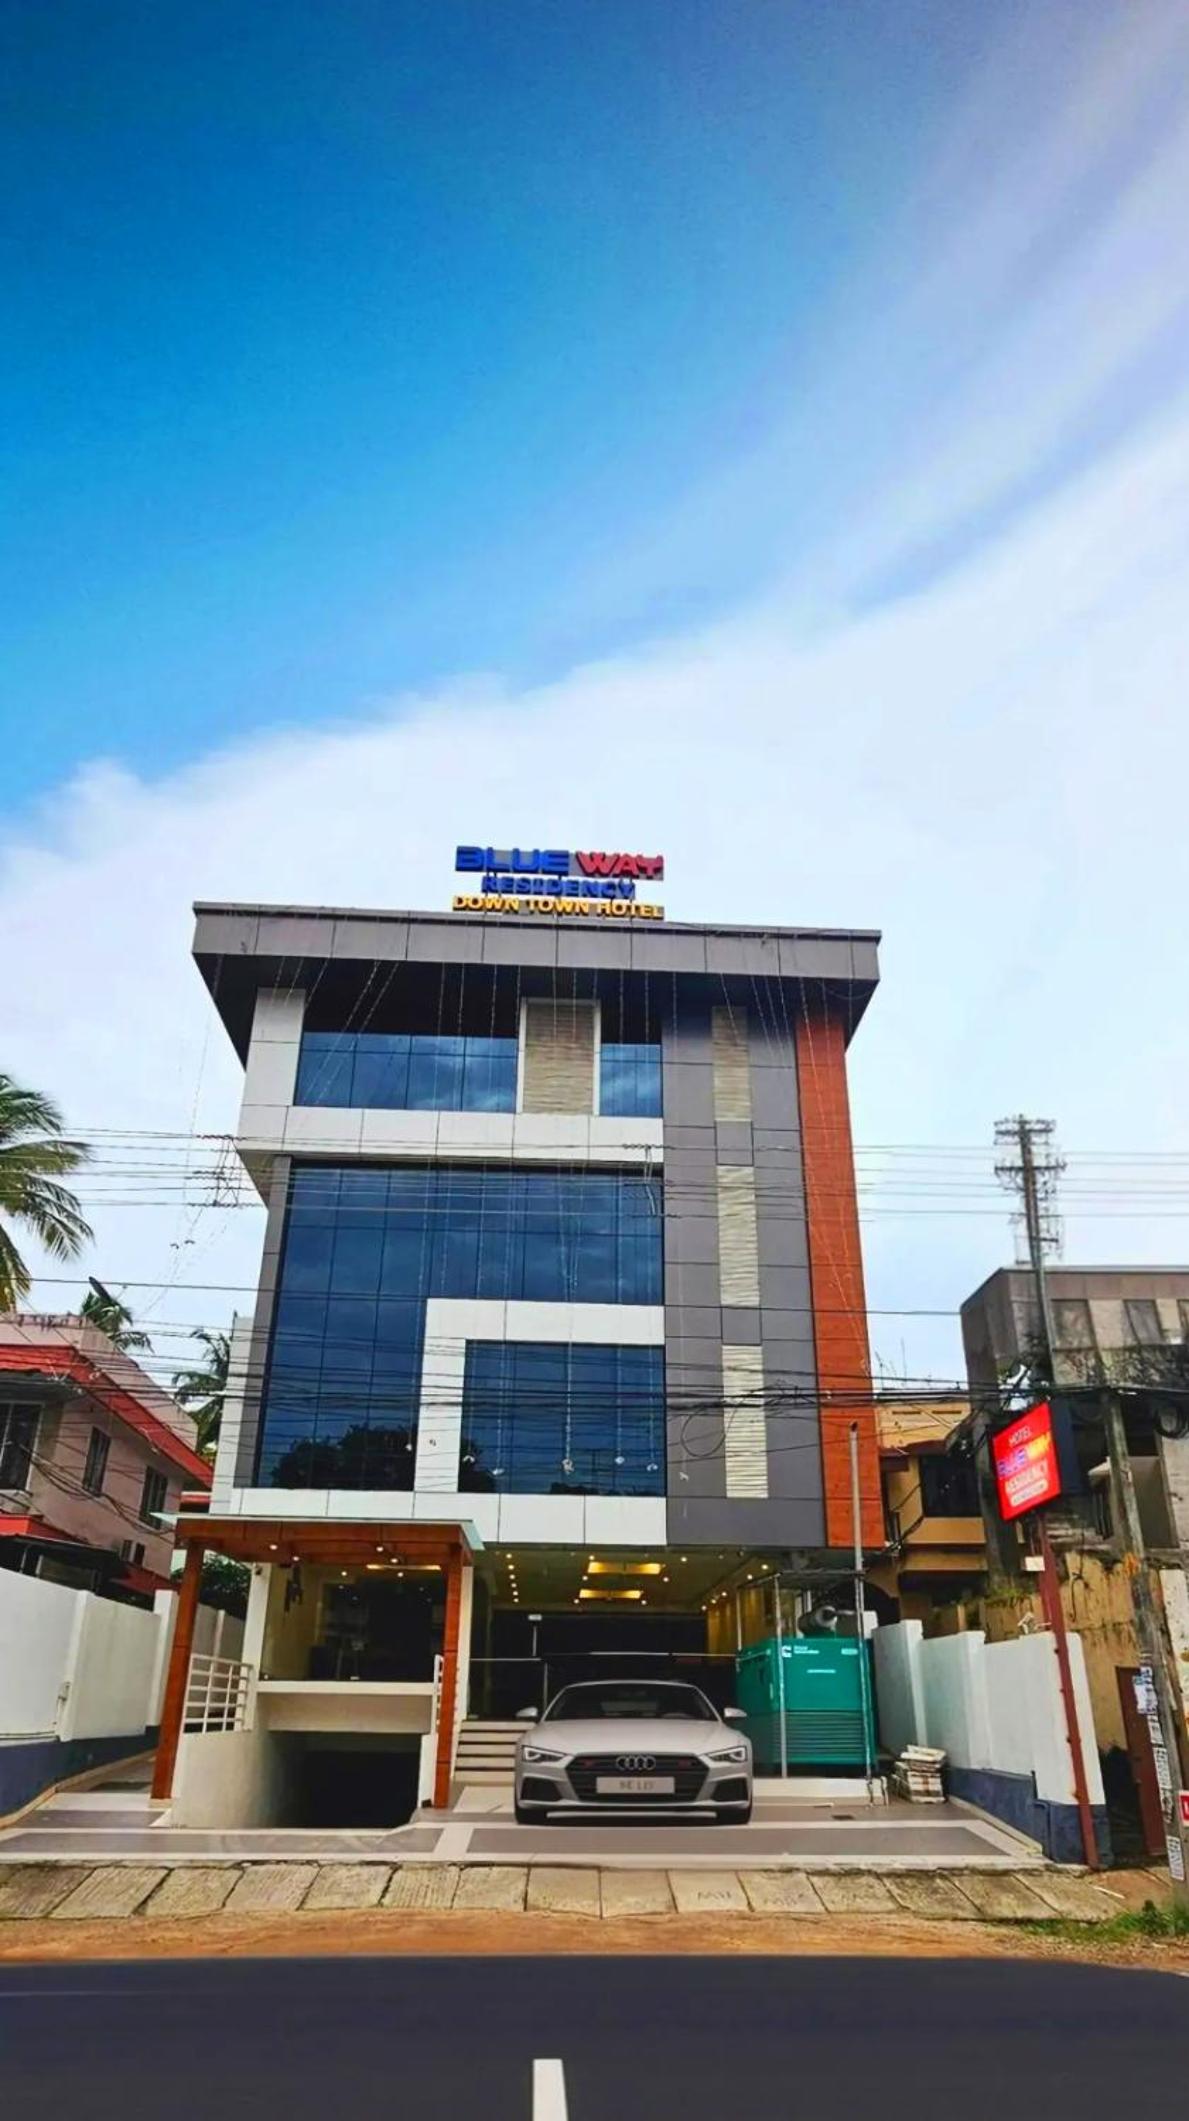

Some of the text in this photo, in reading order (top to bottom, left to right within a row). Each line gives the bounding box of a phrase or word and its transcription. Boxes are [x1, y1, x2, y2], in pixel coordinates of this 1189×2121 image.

[456, 846, 664, 879] BLUE WAY
[481, 876, 634, 899] RESIDENCY
[453, 896, 664, 919] DOWN TOWN HOTEL
